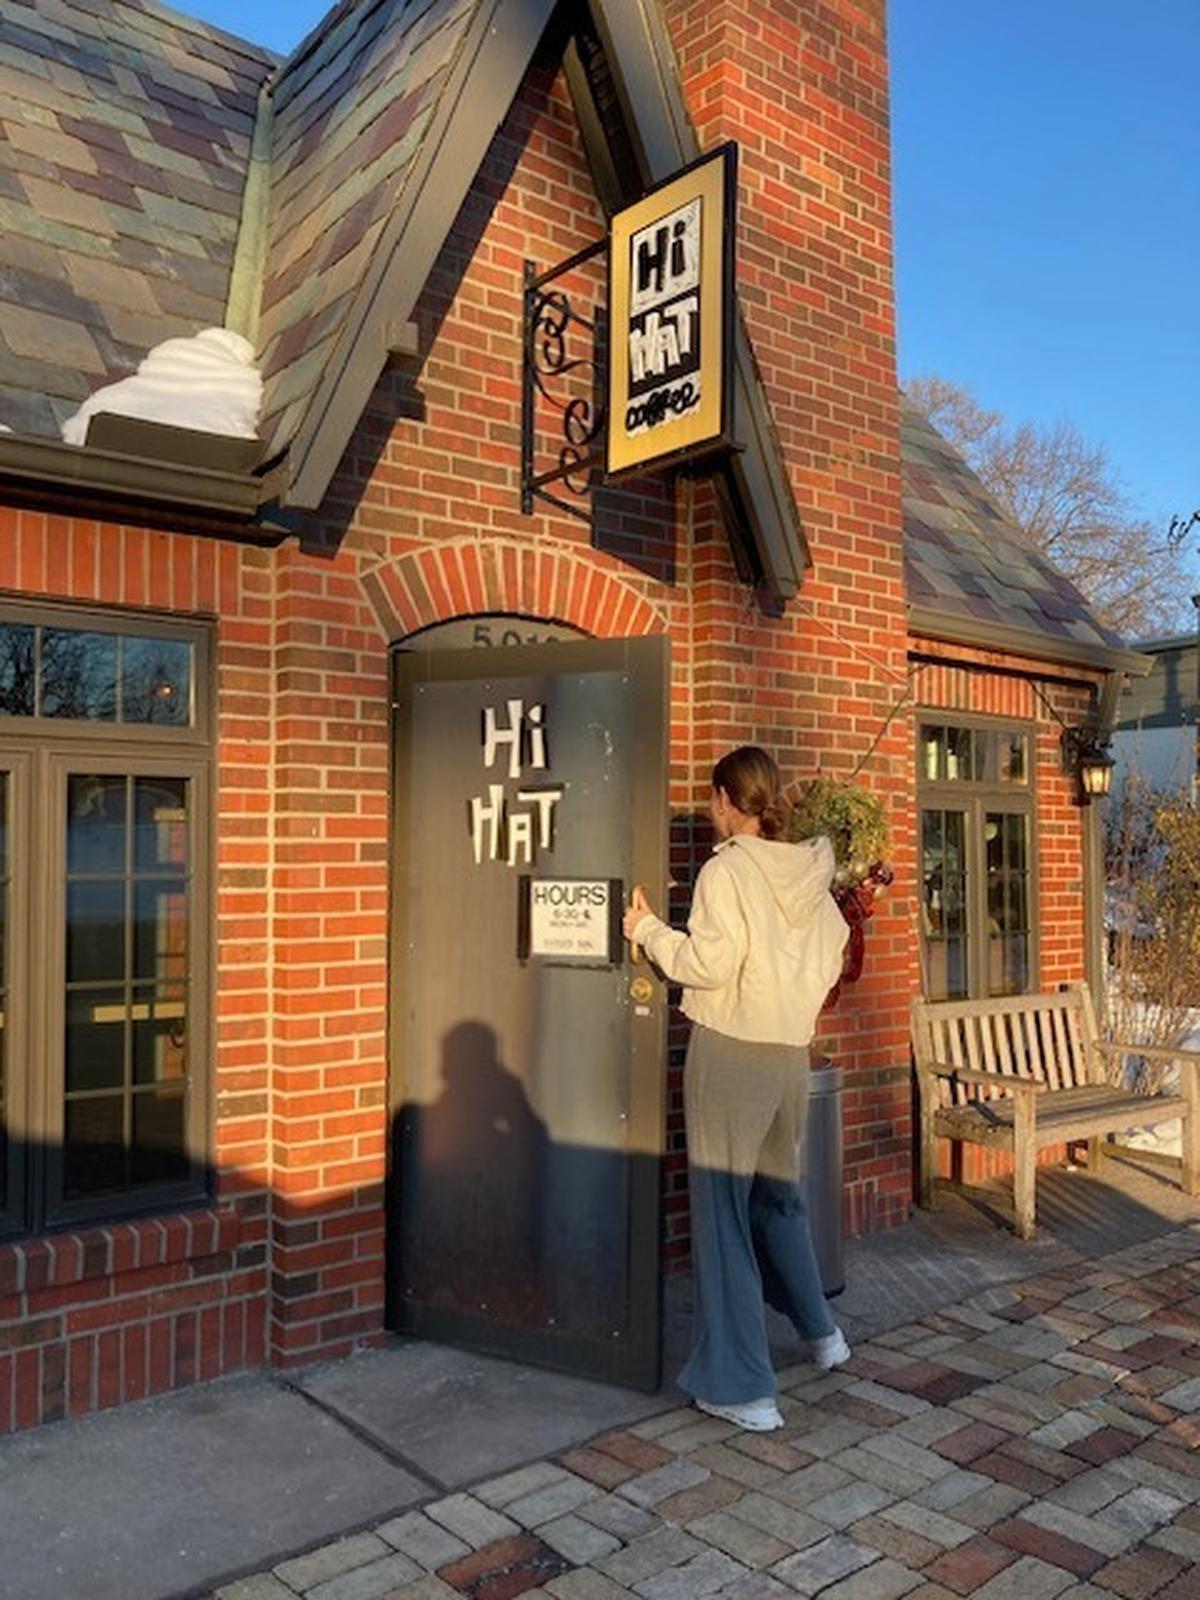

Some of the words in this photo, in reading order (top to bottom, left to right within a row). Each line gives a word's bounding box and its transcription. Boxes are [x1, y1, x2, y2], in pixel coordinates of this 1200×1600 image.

[637, 221, 686, 292] Hi
[629, 297, 698, 382] HAT
[626, 382, 700, 430] coffee
[482, 700, 548, 778] Hi
[469, 784, 564, 867] HAT
[534, 885, 606, 906] HOURS
